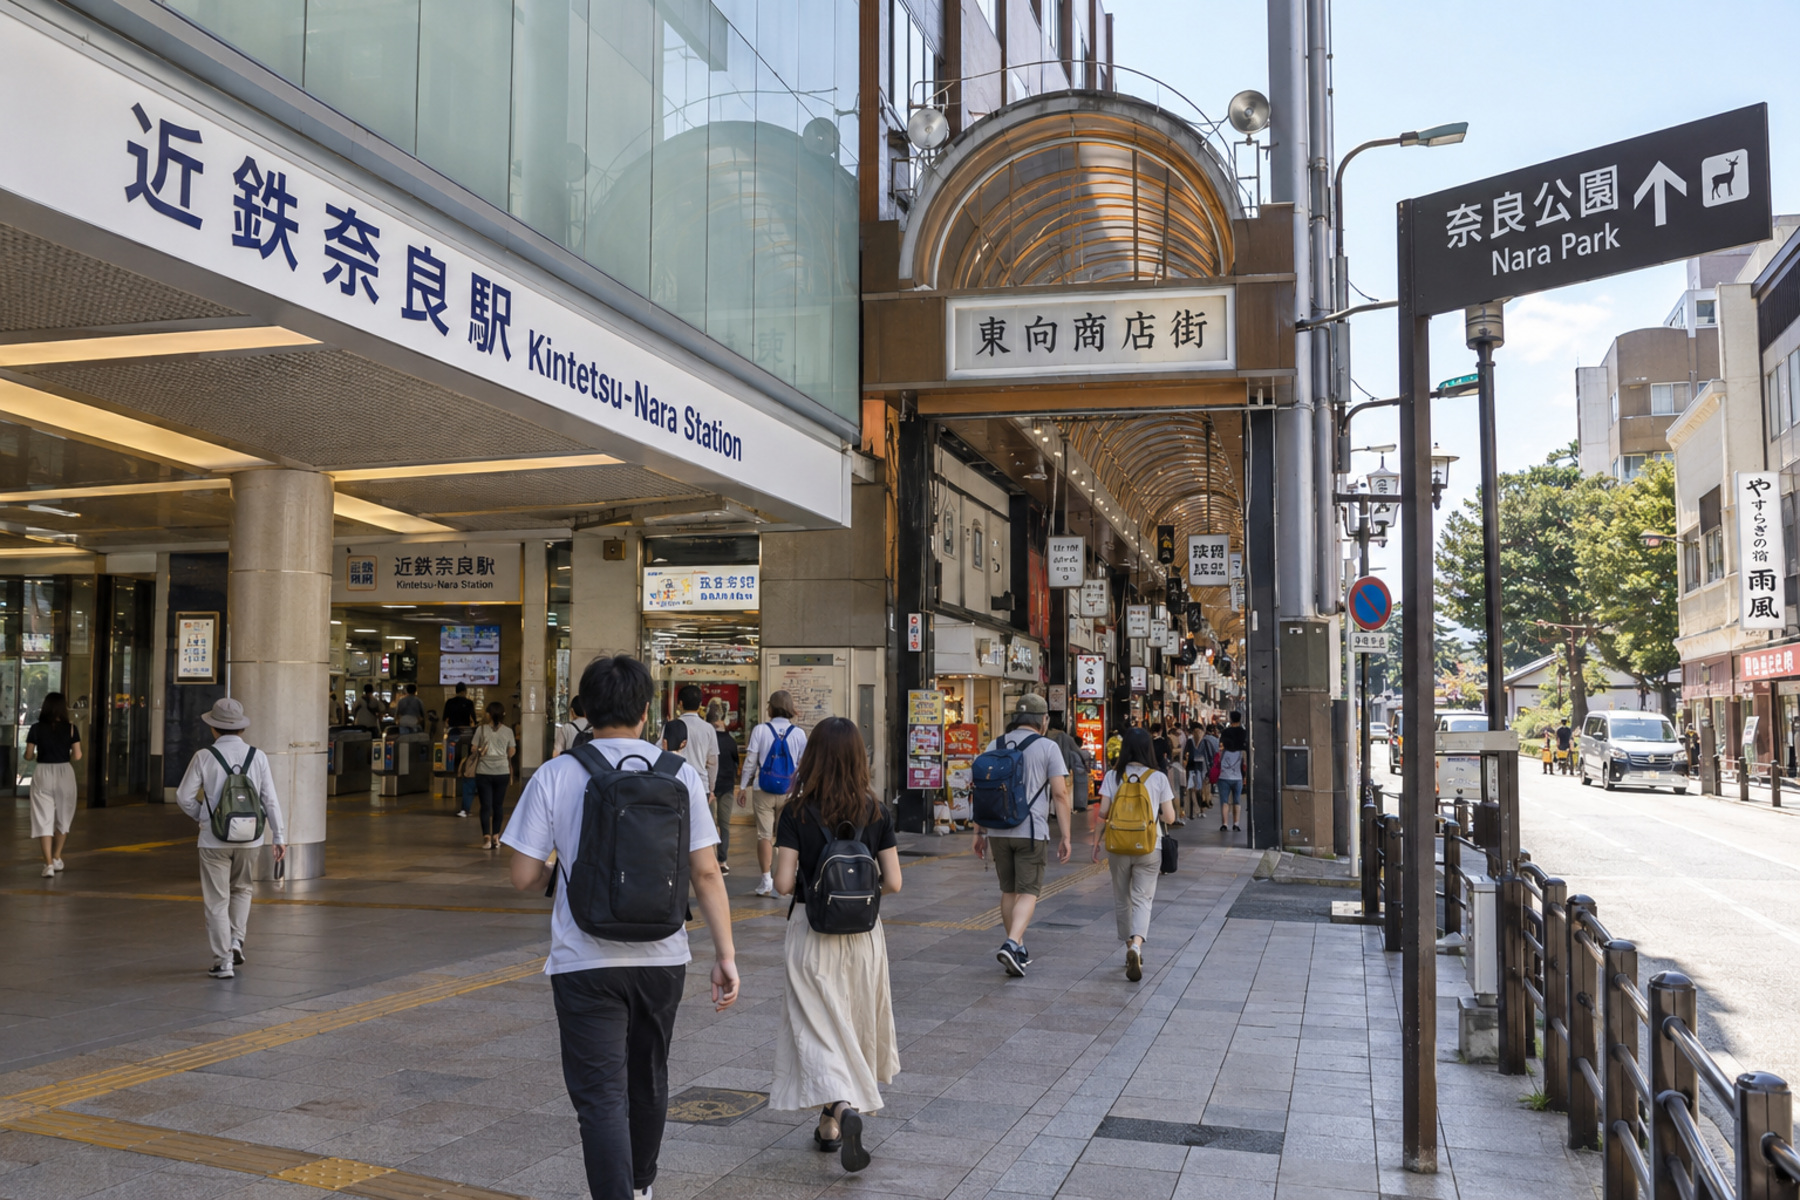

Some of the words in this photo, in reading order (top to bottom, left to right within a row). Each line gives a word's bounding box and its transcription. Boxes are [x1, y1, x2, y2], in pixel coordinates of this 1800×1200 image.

[125, 102, 512, 361] 近鉄奈良駅
[1446, 165, 1619, 249] 奈良公園
[1492, 247, 1551, 276] Nara
[1561, 222, 1621, 260] Park
[976, 309, 1209, 357] 東向商店街
[529, 329, 678, 435] Kintetsu-Nara
[684, 405, 743, 462] Station
[461, 580, 494, 590] Station
[1748, 568, 1779, 619] 雨風
